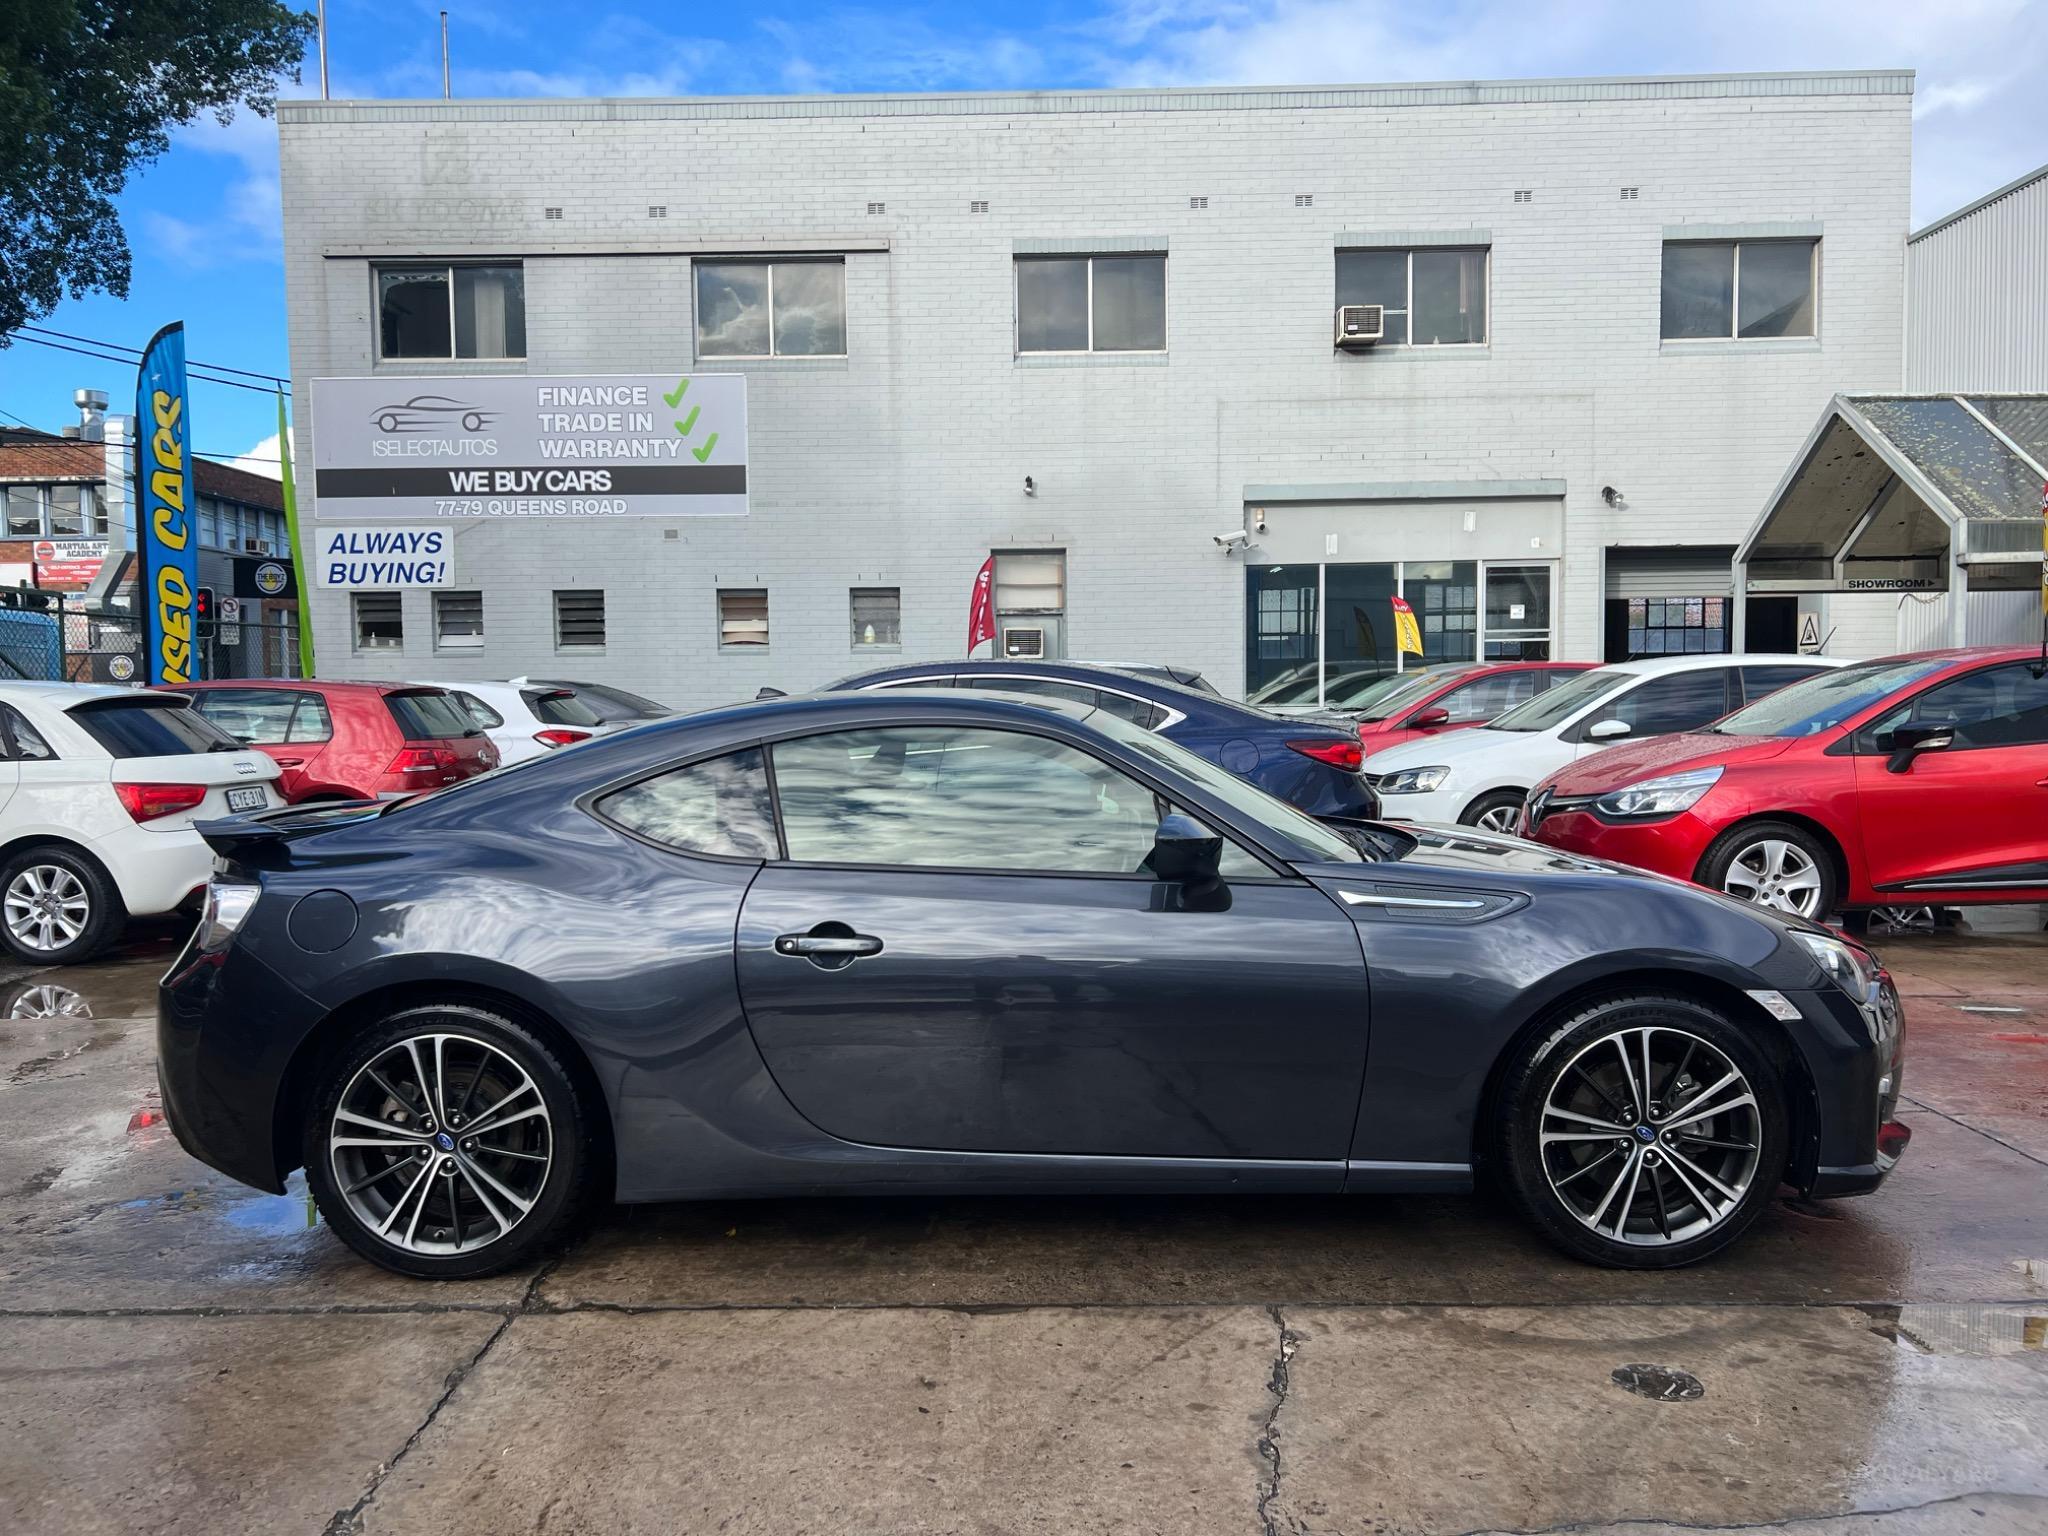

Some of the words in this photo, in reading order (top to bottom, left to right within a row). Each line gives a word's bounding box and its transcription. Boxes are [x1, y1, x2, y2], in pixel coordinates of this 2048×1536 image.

[537, 385, 649, 407] FINANCE
[537, 412, 622, 433] TRADE
[628, 412, 654, 432] IN
[372, 438, 498, 457] ISELECTAUTOS
[537, 438, 684, 459] WARRANTY
[152, 390, 187, 550] CARS
[449, 471, 490, 493] WE
[495, 470, 544, 493] BUY
[545, 469, 613, 492] CARS
[435, 500, 483, 516] 77-79
[487, 499, 567, 516] QUEENS
[571, 499, 628, 515] ROAD
[56, 542, 90, 550] MARTIAL
[92, 542, 110, 550] ART
[327, 531, 443, 555] ALWAYS
[328, 562, 446, 584] BUYING!
[1848, 579, 1926, 589] SHOWROOM
